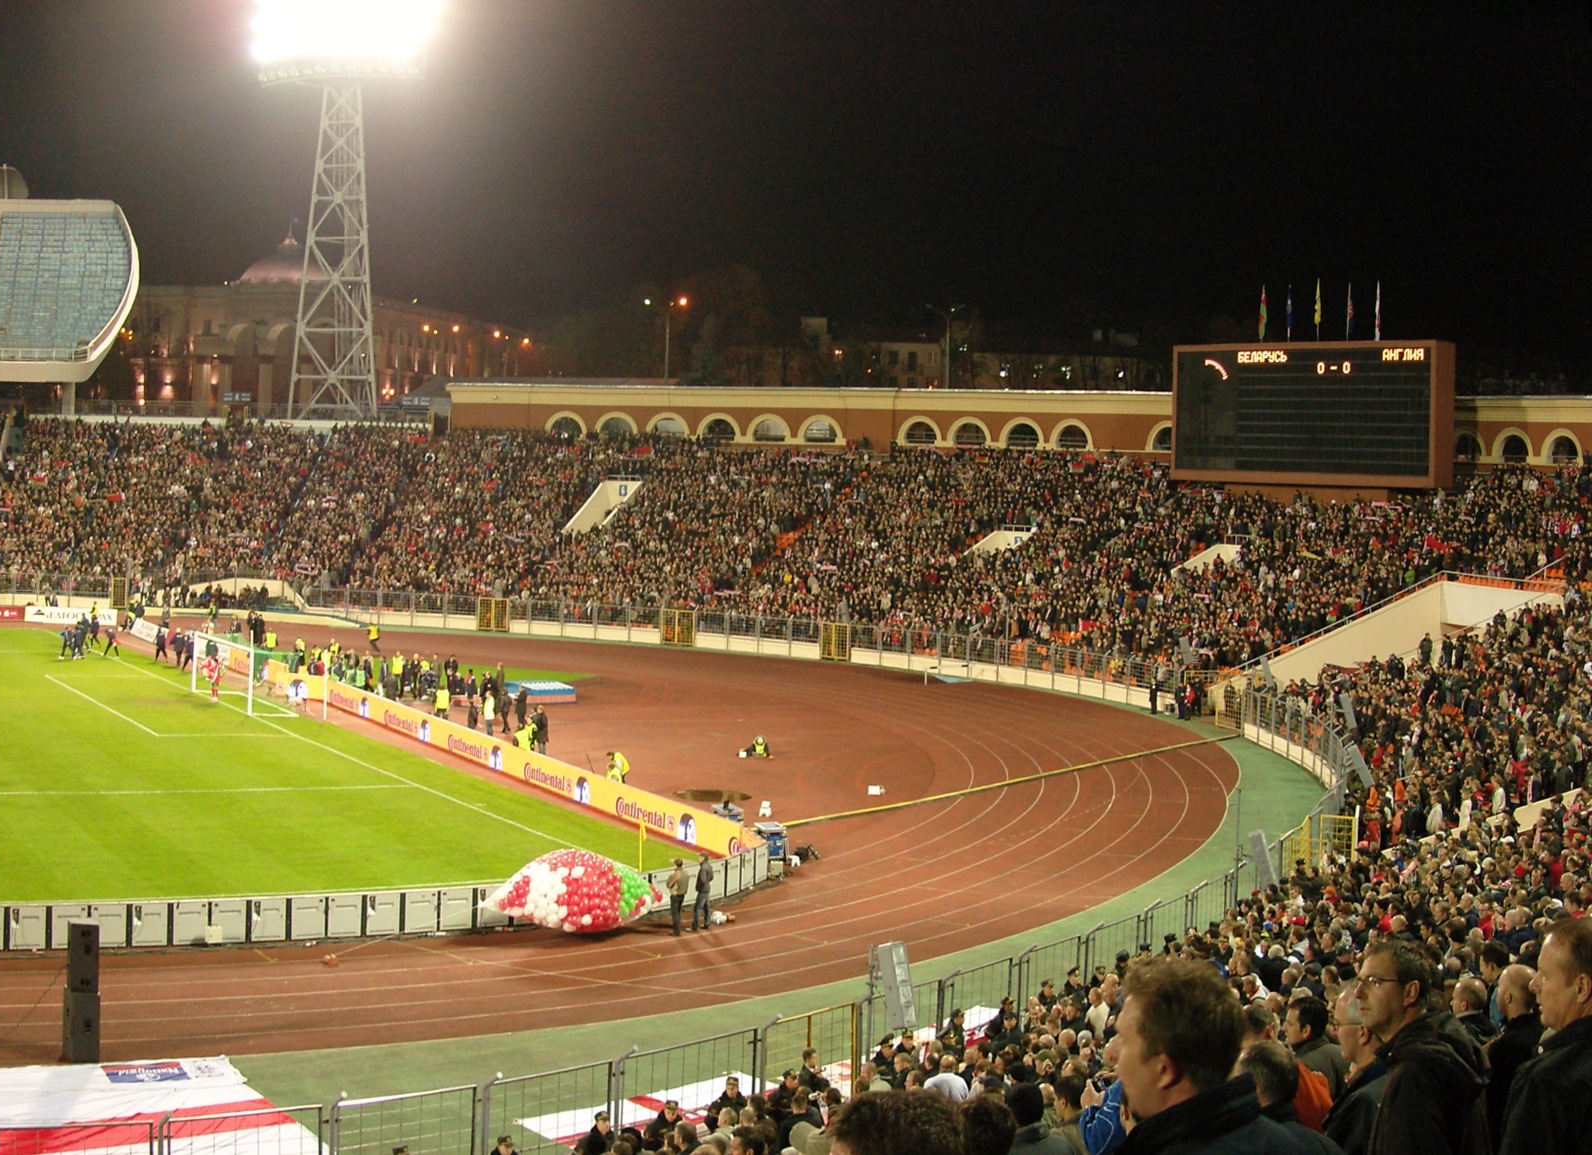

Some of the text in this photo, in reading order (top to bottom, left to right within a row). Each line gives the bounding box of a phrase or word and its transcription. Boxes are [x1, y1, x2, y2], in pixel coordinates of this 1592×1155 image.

[1237, 351, 1288, 363] БЕЛАРУСЬ
[1382, 348, 1425, 361] АНГЛИЯ
[1317, 361, 1325, 374] 0
[1343, 361, 1351, 374] 0
[384, 709, 414, 732] Continental
[448, 734, 482, 760] Continental
[524, 762, 565, 791] Continental
[616, 796, 666, 830] Continental
